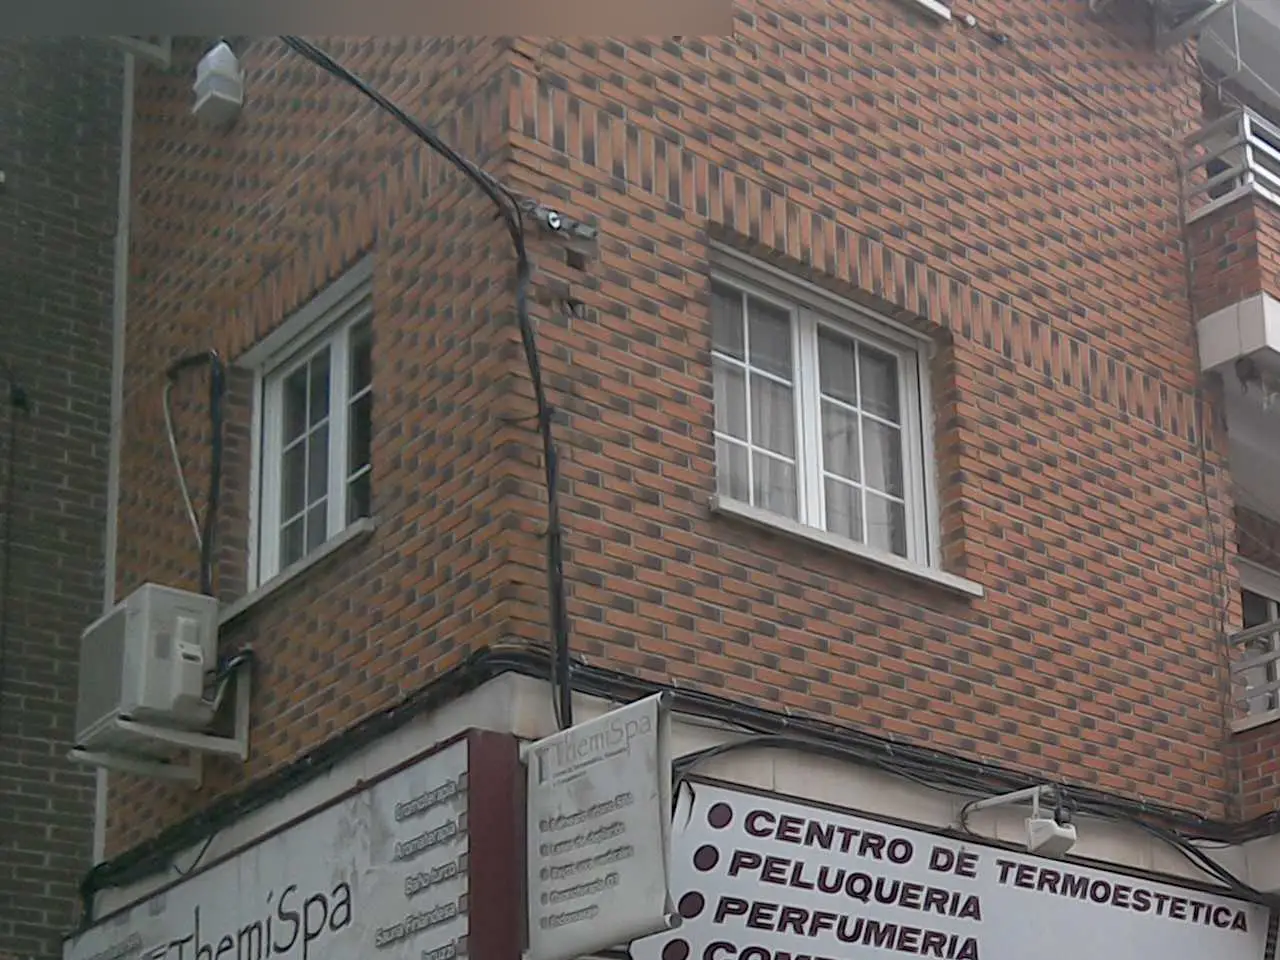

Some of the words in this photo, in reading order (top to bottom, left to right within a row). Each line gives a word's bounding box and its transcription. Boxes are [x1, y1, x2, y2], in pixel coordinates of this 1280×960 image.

[728, 849, 982, 921] PELUQUERIA
[744, 809, 914, 864] CENTRO
[928, 845, 978, 878] DE
[996, 859, 1248, 932] TERMOESTETICA
